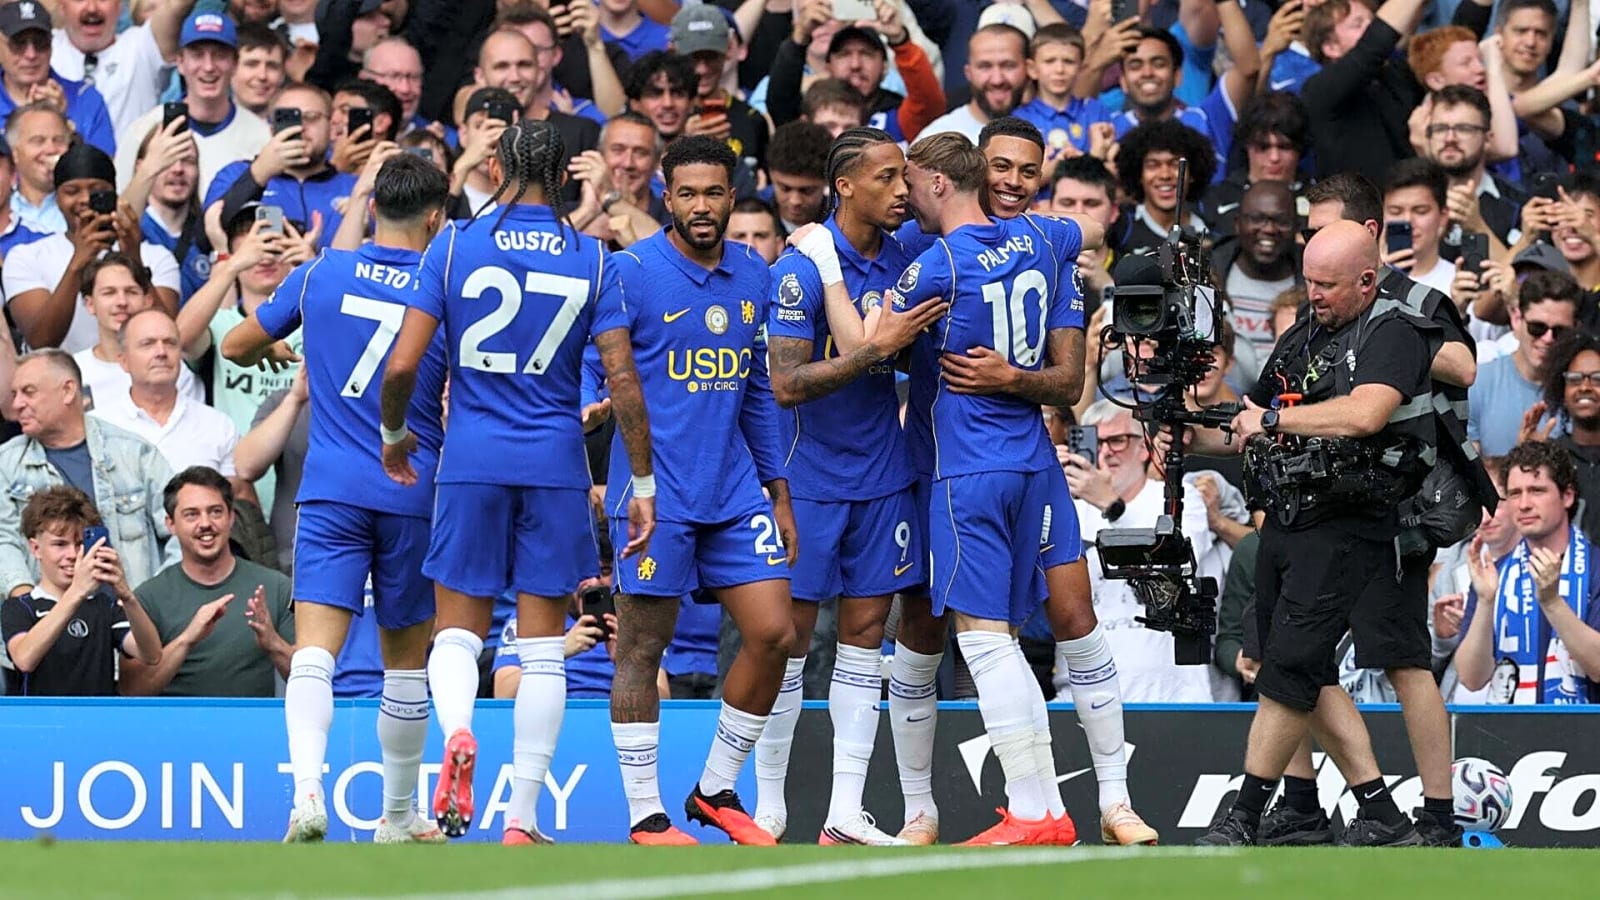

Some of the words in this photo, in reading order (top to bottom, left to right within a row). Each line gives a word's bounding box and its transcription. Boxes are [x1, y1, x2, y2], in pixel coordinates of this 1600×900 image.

[495, 230, 565, 256] GUSTO
[977, 234, 1035, 272] PALMER
[355, 262, 411, 289] NETO
[459, 265, 591, 375] 27
[981, 269, 1048, 367] 10
[340, 293, 406, 398] 7
[668, 347, 752, 380] USDC
[701, 382, 713, 391] BY
[894, 521, 911, 562] 9
[20, 760, 244, 829] JOIN
[1177, 750, 1600, 832] nkefo
